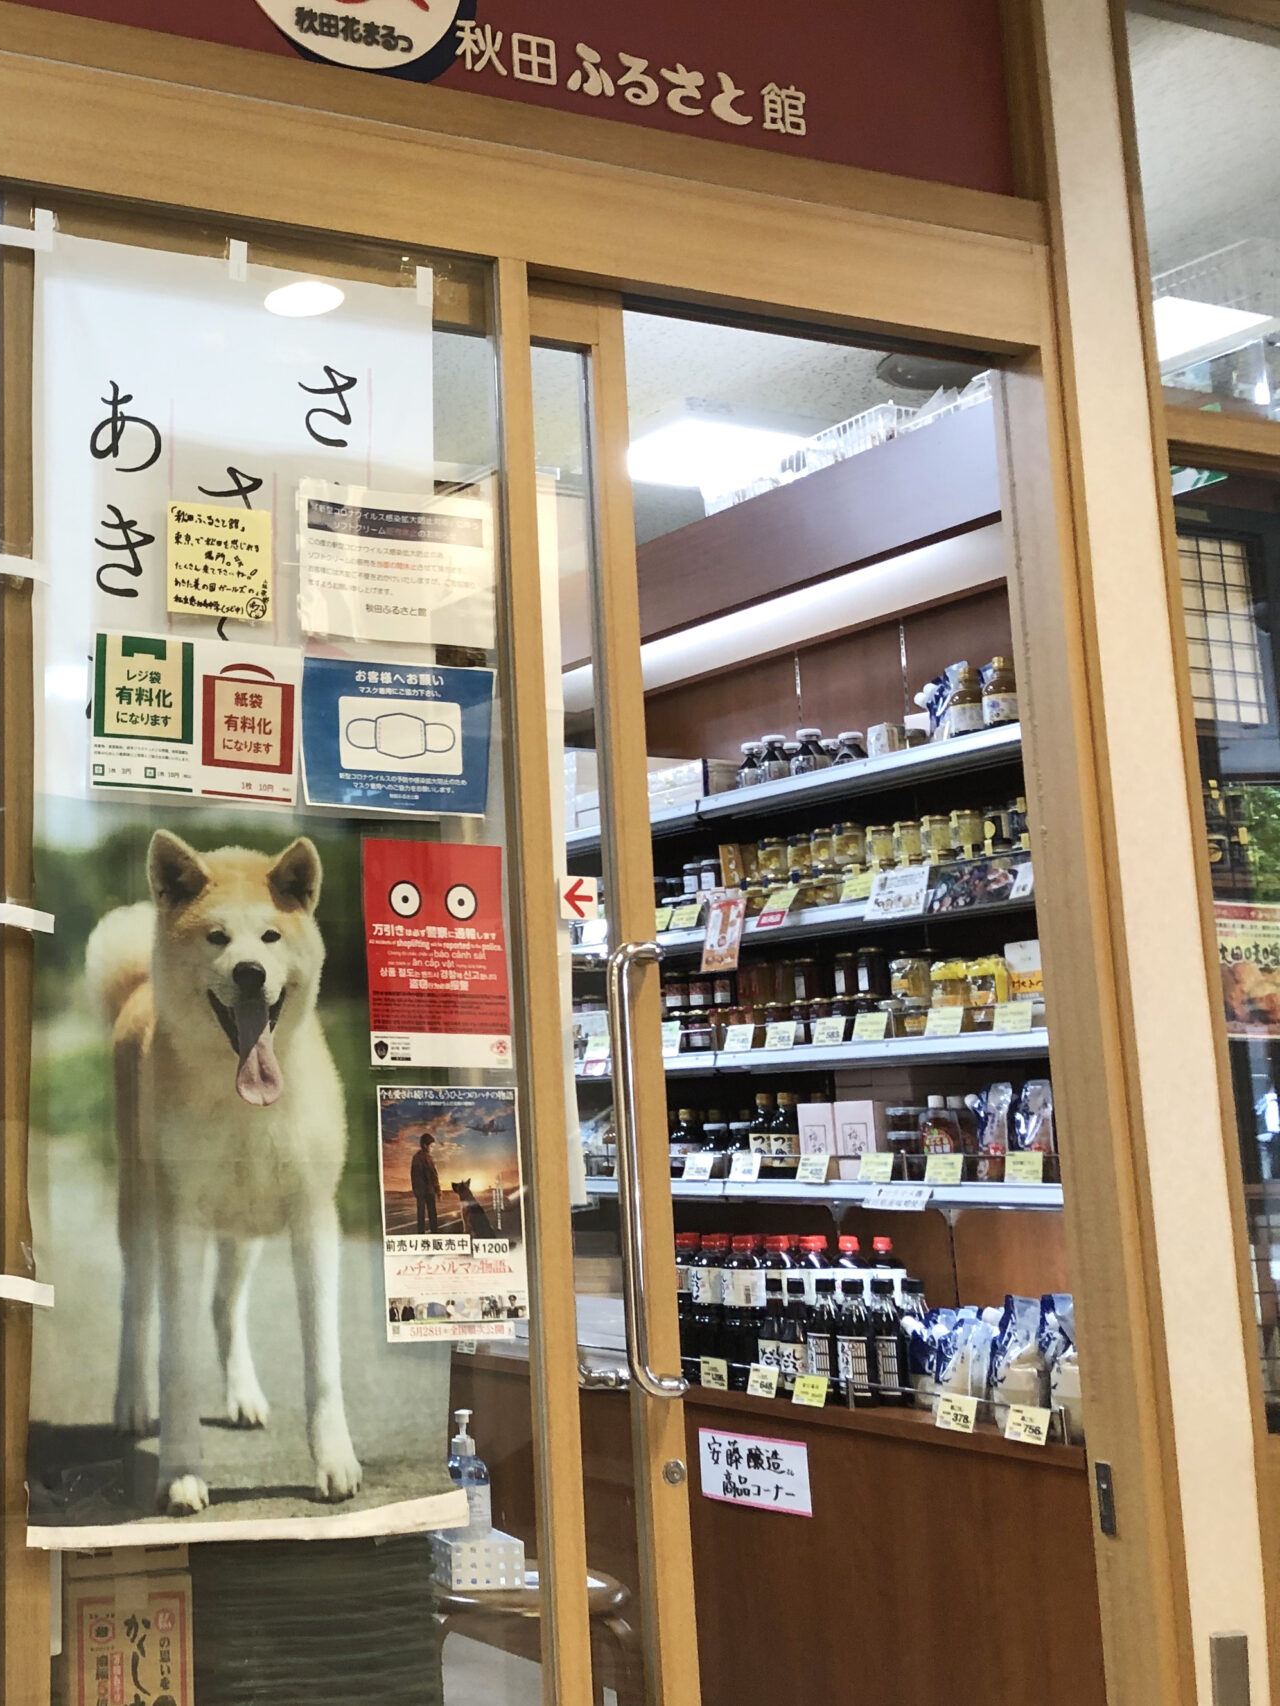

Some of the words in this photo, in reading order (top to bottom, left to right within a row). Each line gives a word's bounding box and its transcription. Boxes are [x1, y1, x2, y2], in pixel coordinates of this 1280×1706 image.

[294, 6, 414, 54] 秋田花まるっ
[455, 19, 809, 137] 秋田ふるさと館
[365, 603, 427, 617] 秋田ふるさと館
[126, 668, 162, 685] レジ袋
[354, 669, 445, 687] お客様へお願い
[115, 685, 173, 709] 有料化
[233, 691, 264, 710] 紙袋
[116, 710, 172, 728] になります
[223, 714, 273, 736] 有料化
[222, 737, 273, 755] になります
[385, 1238, 470, 1252] 前売り券販売中
[473, 1242, 509, 1254] ¥1200
